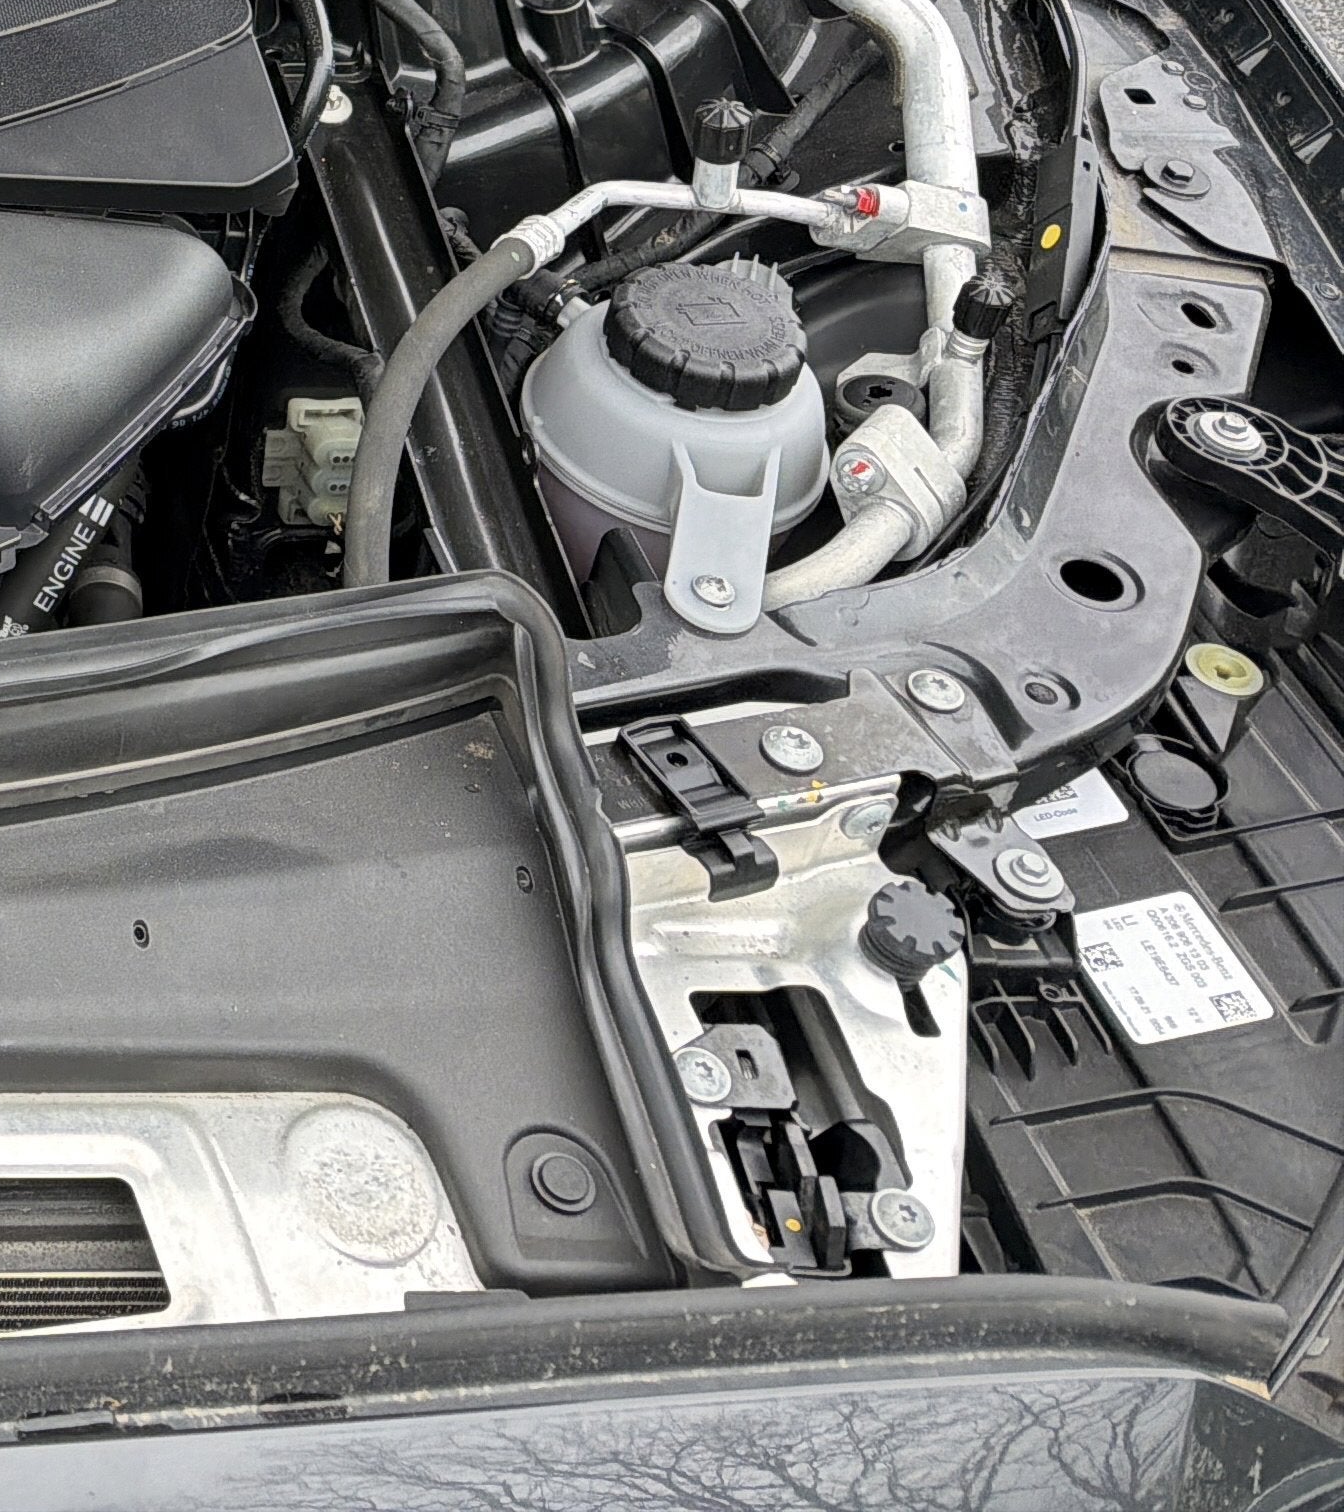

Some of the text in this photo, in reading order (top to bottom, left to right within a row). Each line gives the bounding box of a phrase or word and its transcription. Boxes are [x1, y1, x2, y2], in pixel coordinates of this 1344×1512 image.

[696, 270, 740, 289] WHEN
[32, 522, 96, 612] ENGINE
[1033, 808, 1078, 822] LED-Code
[1181, 912, 1233, 980] Mercedes-Benz
